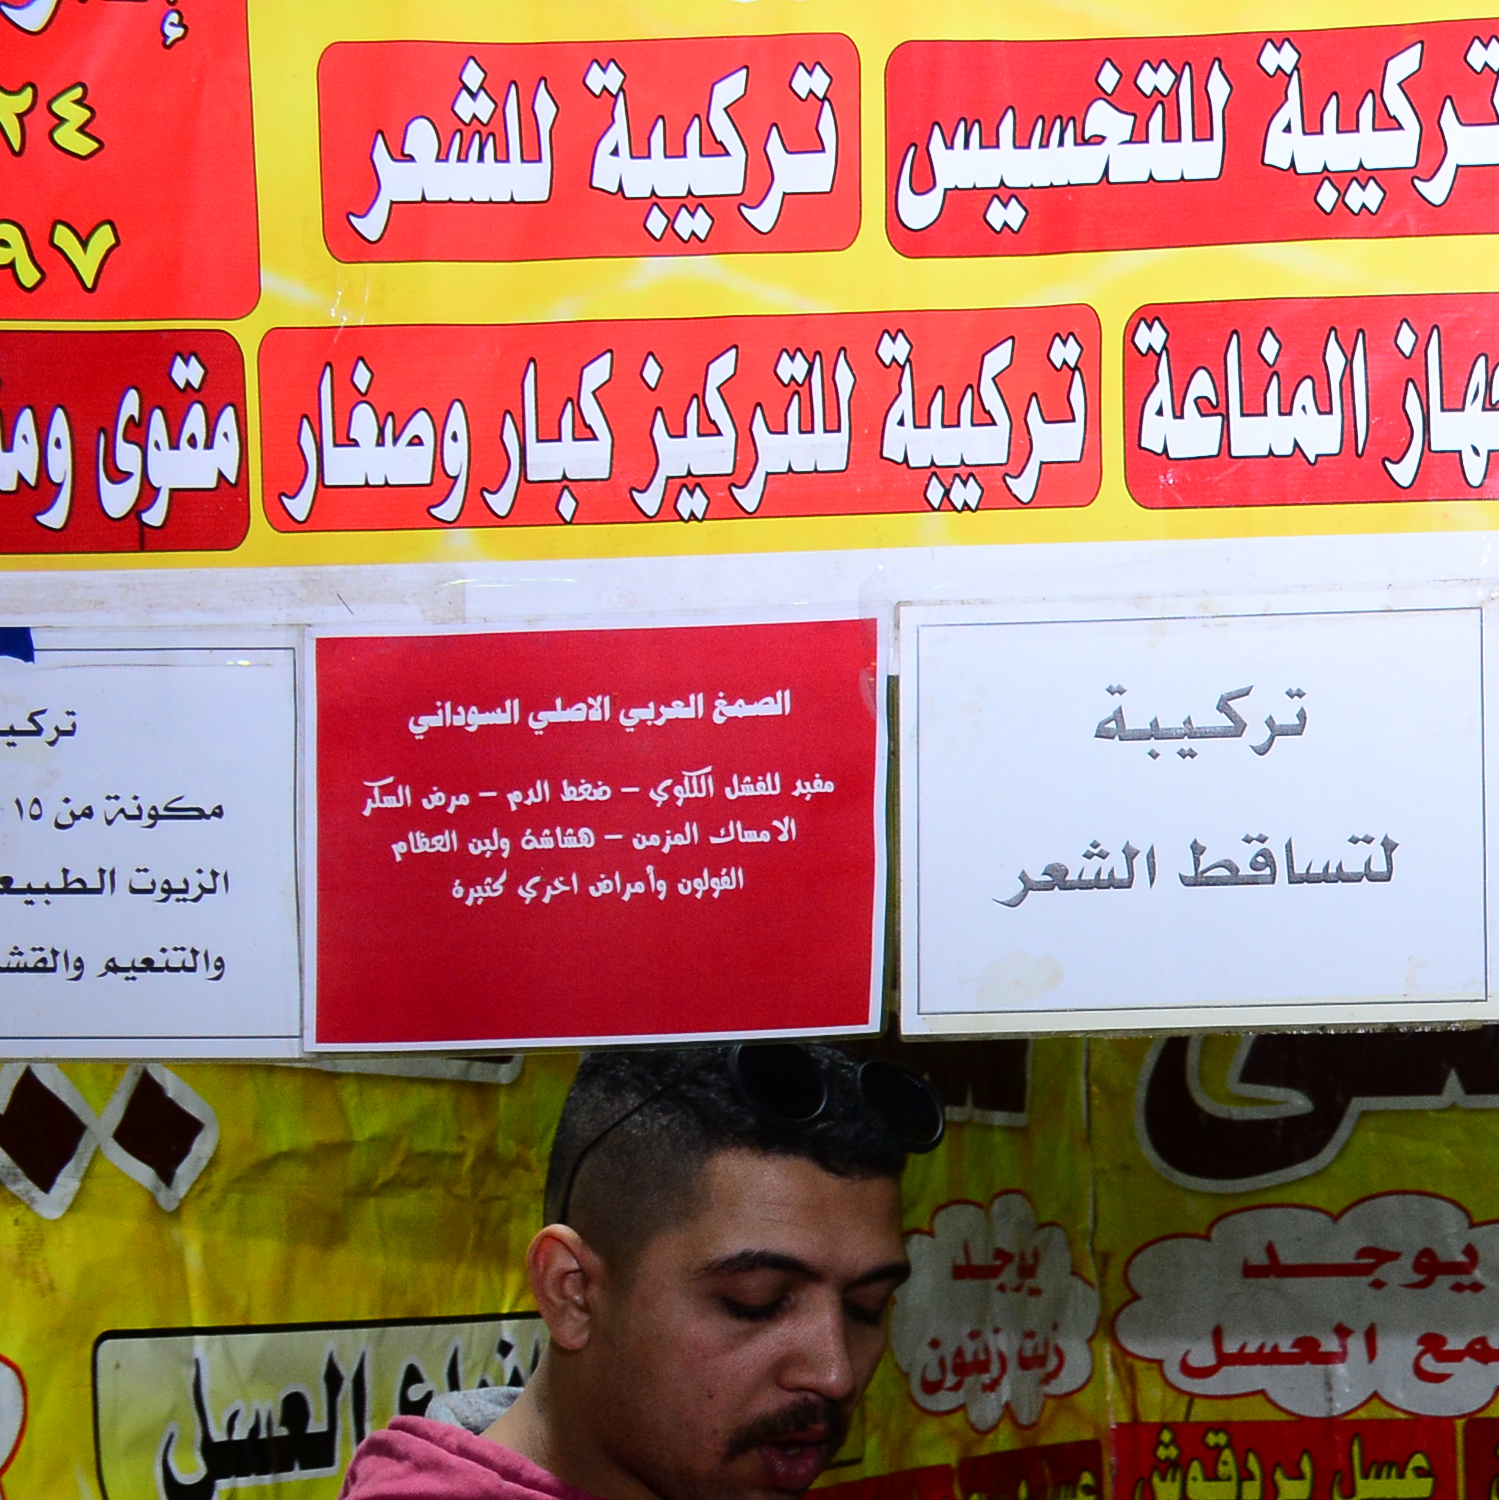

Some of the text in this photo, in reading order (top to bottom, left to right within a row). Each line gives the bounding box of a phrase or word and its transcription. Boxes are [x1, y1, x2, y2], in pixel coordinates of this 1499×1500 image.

[347, 55, 840, 242] تركيبة للشعر
[894, 56, 1233, 231] للتخسيس
[1133, 318, 1369, 464] المناعة
[96, 352, 242, 527] مقوى
[279, 326, 1088, 523] تركيبة للتركيز كبار وصغار
[408, 689, 791, 739] الصمغ العربي الاصلي السوداني
[1094, 683, 1308, 759] تركيبة
[362, 776, 411, 815] السكر
[421, 786, 470, 813] مرض
[507, 779, 550, 811] الدم
[561, 779, 611, 802] ضغط
[724, 772, 780, 801] للفشل
[792, 773, 835, 801] مفيد
[15, 795, 225, 830] مكونة من ١٥
[709, 816, 797, 845] الامساك
[391, 831, 457, 862] العظام
[521, 827, 595, 850] هشاشة
[632, 821, 698, 853] المزمن
[128, 867, 229, 904] الزيوت
[451, 869, 507, 906] كثيرة
[588, 865, 666, 900] وأمراض
[677, 867, 744, 898] القولون
[992, 832, 1399, 908] لتساقط الشعر
[96, 946, 226, 982] والتنعيم
[1241, 1240, 1480, 1294] يوجد
[1179, 1321, 1376, 1380] العسل
